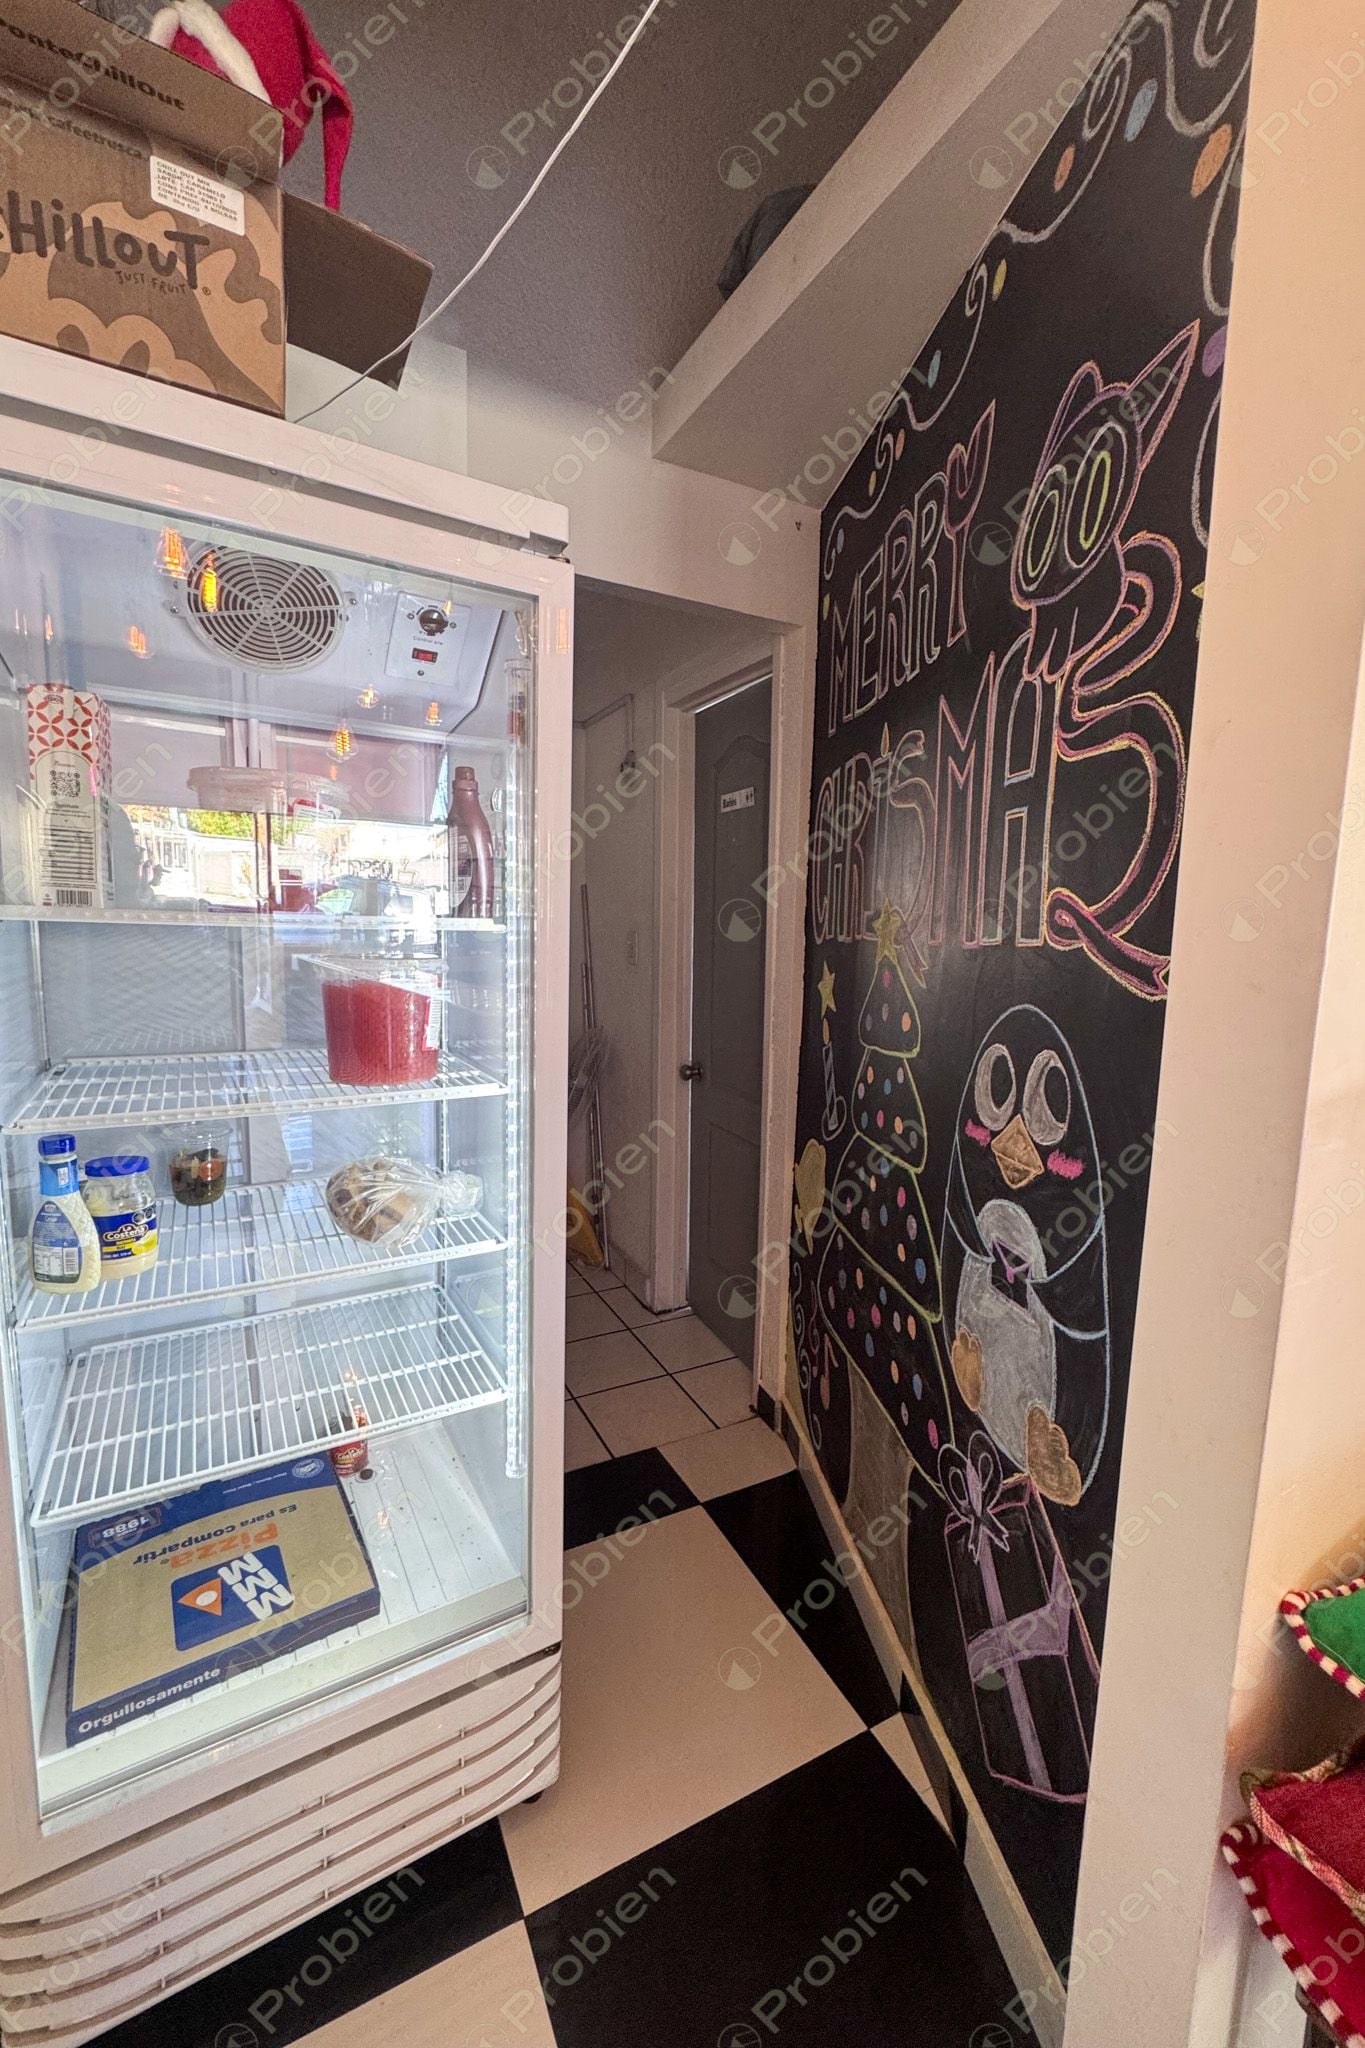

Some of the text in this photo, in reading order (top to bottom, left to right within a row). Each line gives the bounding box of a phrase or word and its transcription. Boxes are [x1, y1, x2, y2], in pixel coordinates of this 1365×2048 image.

[180, 170, 194, 180] OUT
[115, 270, 186, 295] JUST FRUIT
[827, 400, 995, 738] MERRY
[240, 1510, 275, 1527] para
[279, 1503, 297, 1514] Es
[102, 1515, 150, 1538] 1988
[133, 1524, 236, 1566] compartir
[169, 1522, 279, 1569] Pizza
[78, 1667, 221, 1734] Orgullosamente
